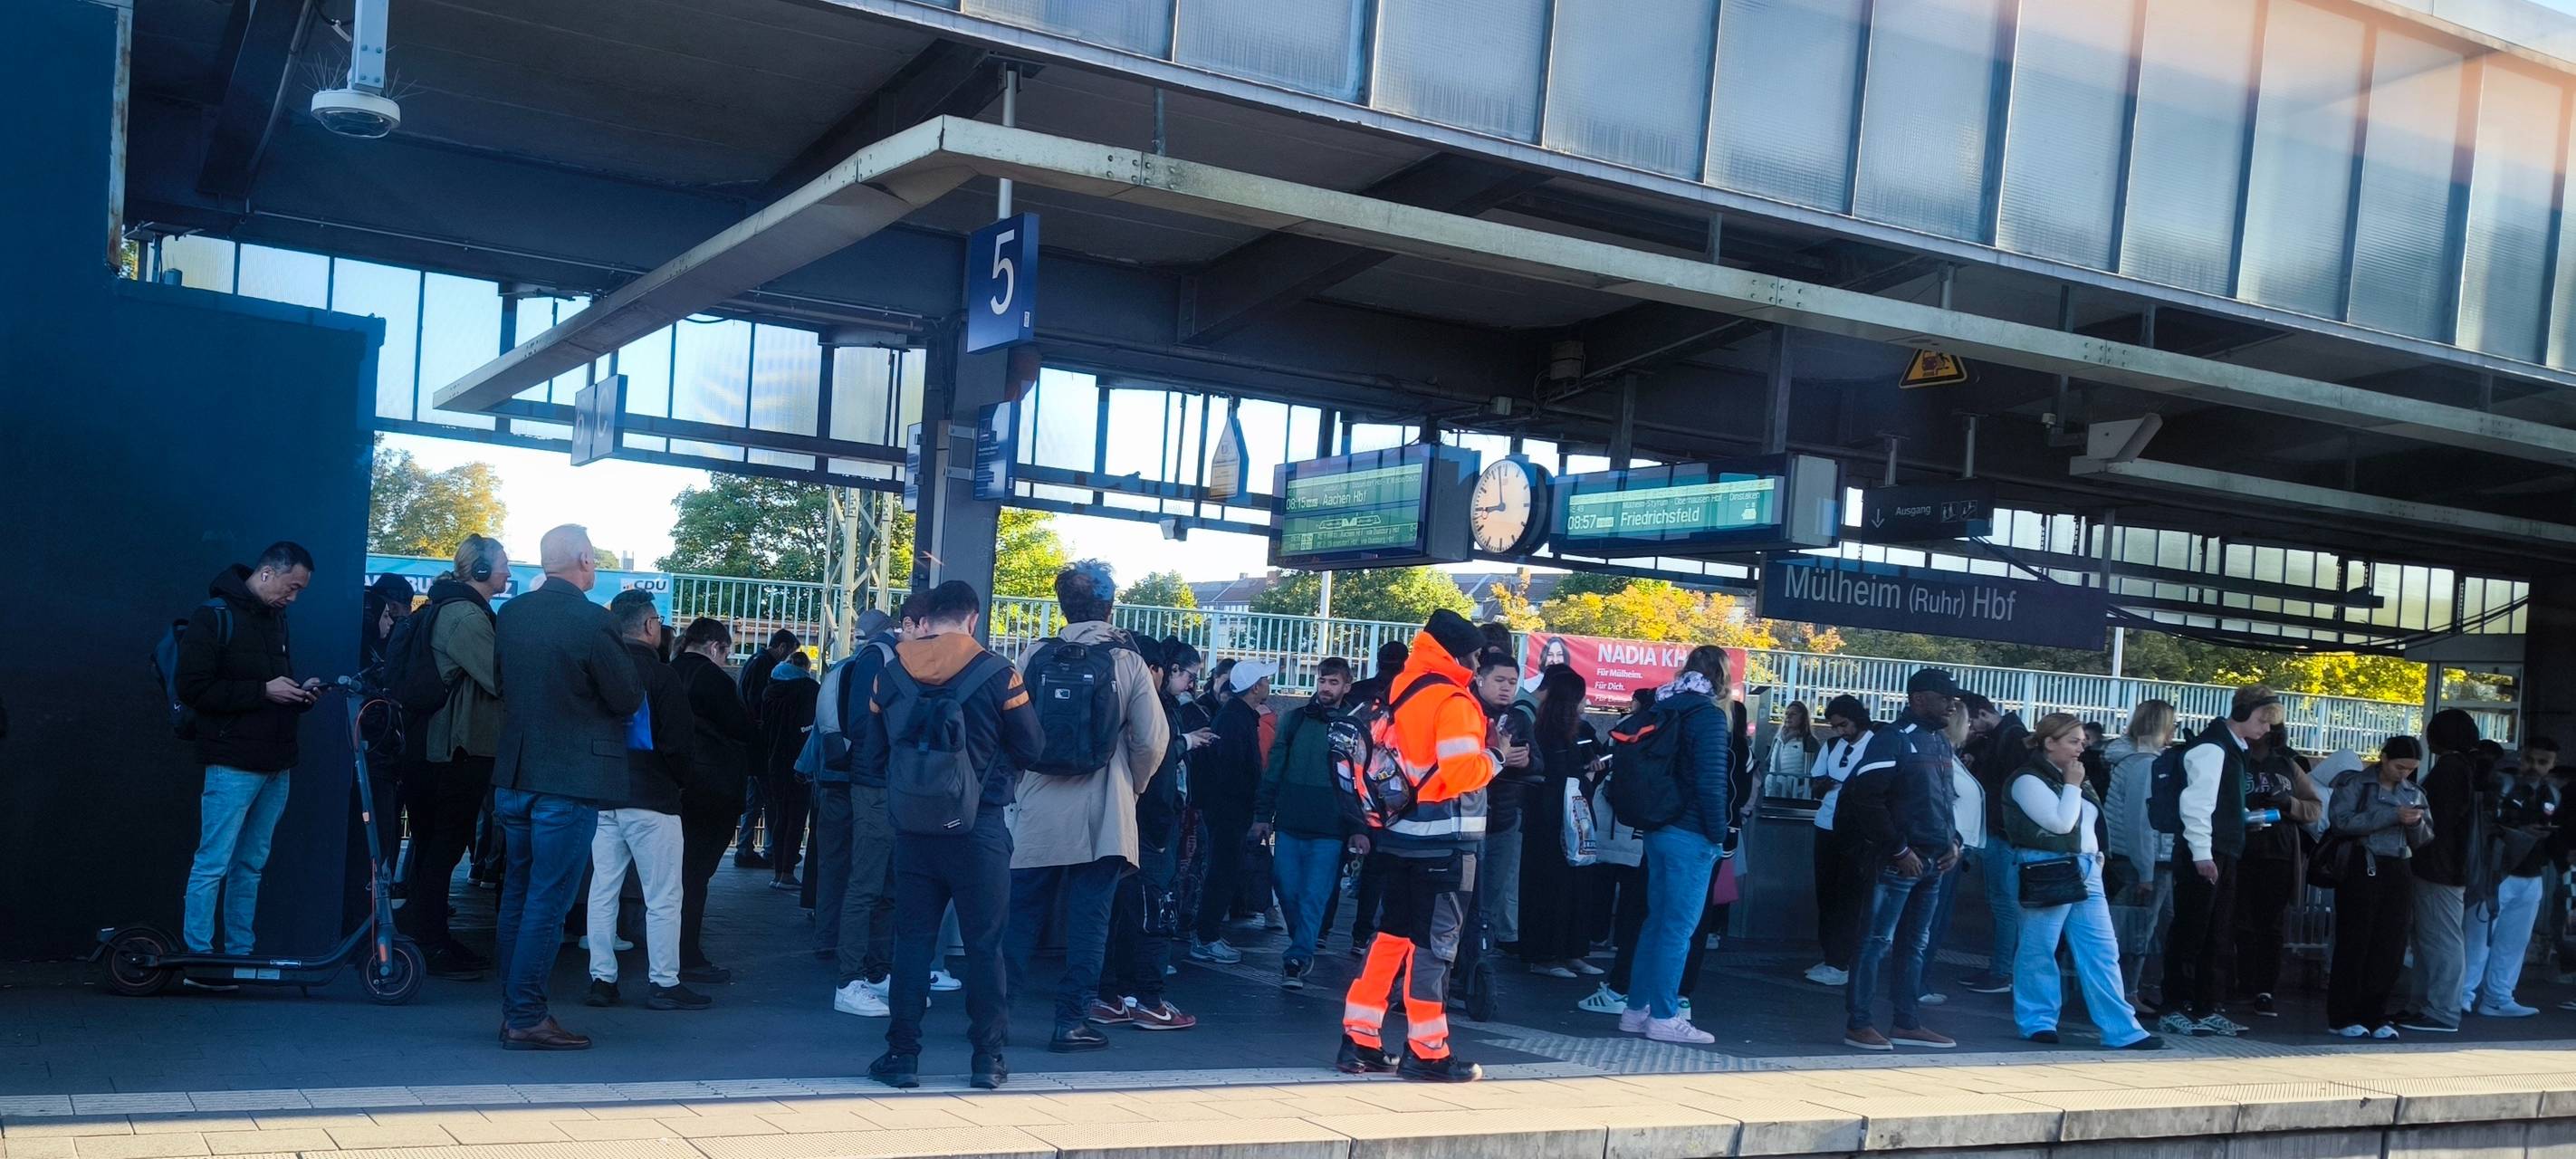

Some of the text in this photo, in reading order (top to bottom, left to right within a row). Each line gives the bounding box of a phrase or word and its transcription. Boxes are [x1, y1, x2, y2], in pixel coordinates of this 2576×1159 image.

[991, 229, 1015, 315] 5
[1286, 496, 1307, 510] 08:15
[1323, 493, 1351, 507] Aachen
[1353, 489, 1367, 503] Hbf
[1674, 495, 1710, 505] Obehausen
[1729, 492, 1761, 501] Dinslaken
[1567, 514, 1597, 530] 08:57
[1620, 507, 1700, 526] Friedrichsfeld
[1895, 505, 1931, 517] Ausgang
[634, 580, 666, 590] CDU
[1784, 564, 2016, 621] Mülheim (Ruhr) Hbf
[1597, 644, 1688, 668] NADIA KH
[1596, 668, 1643, 679] Für Mülheim.
[1594, 681, 1626, 691] Für Dich.
